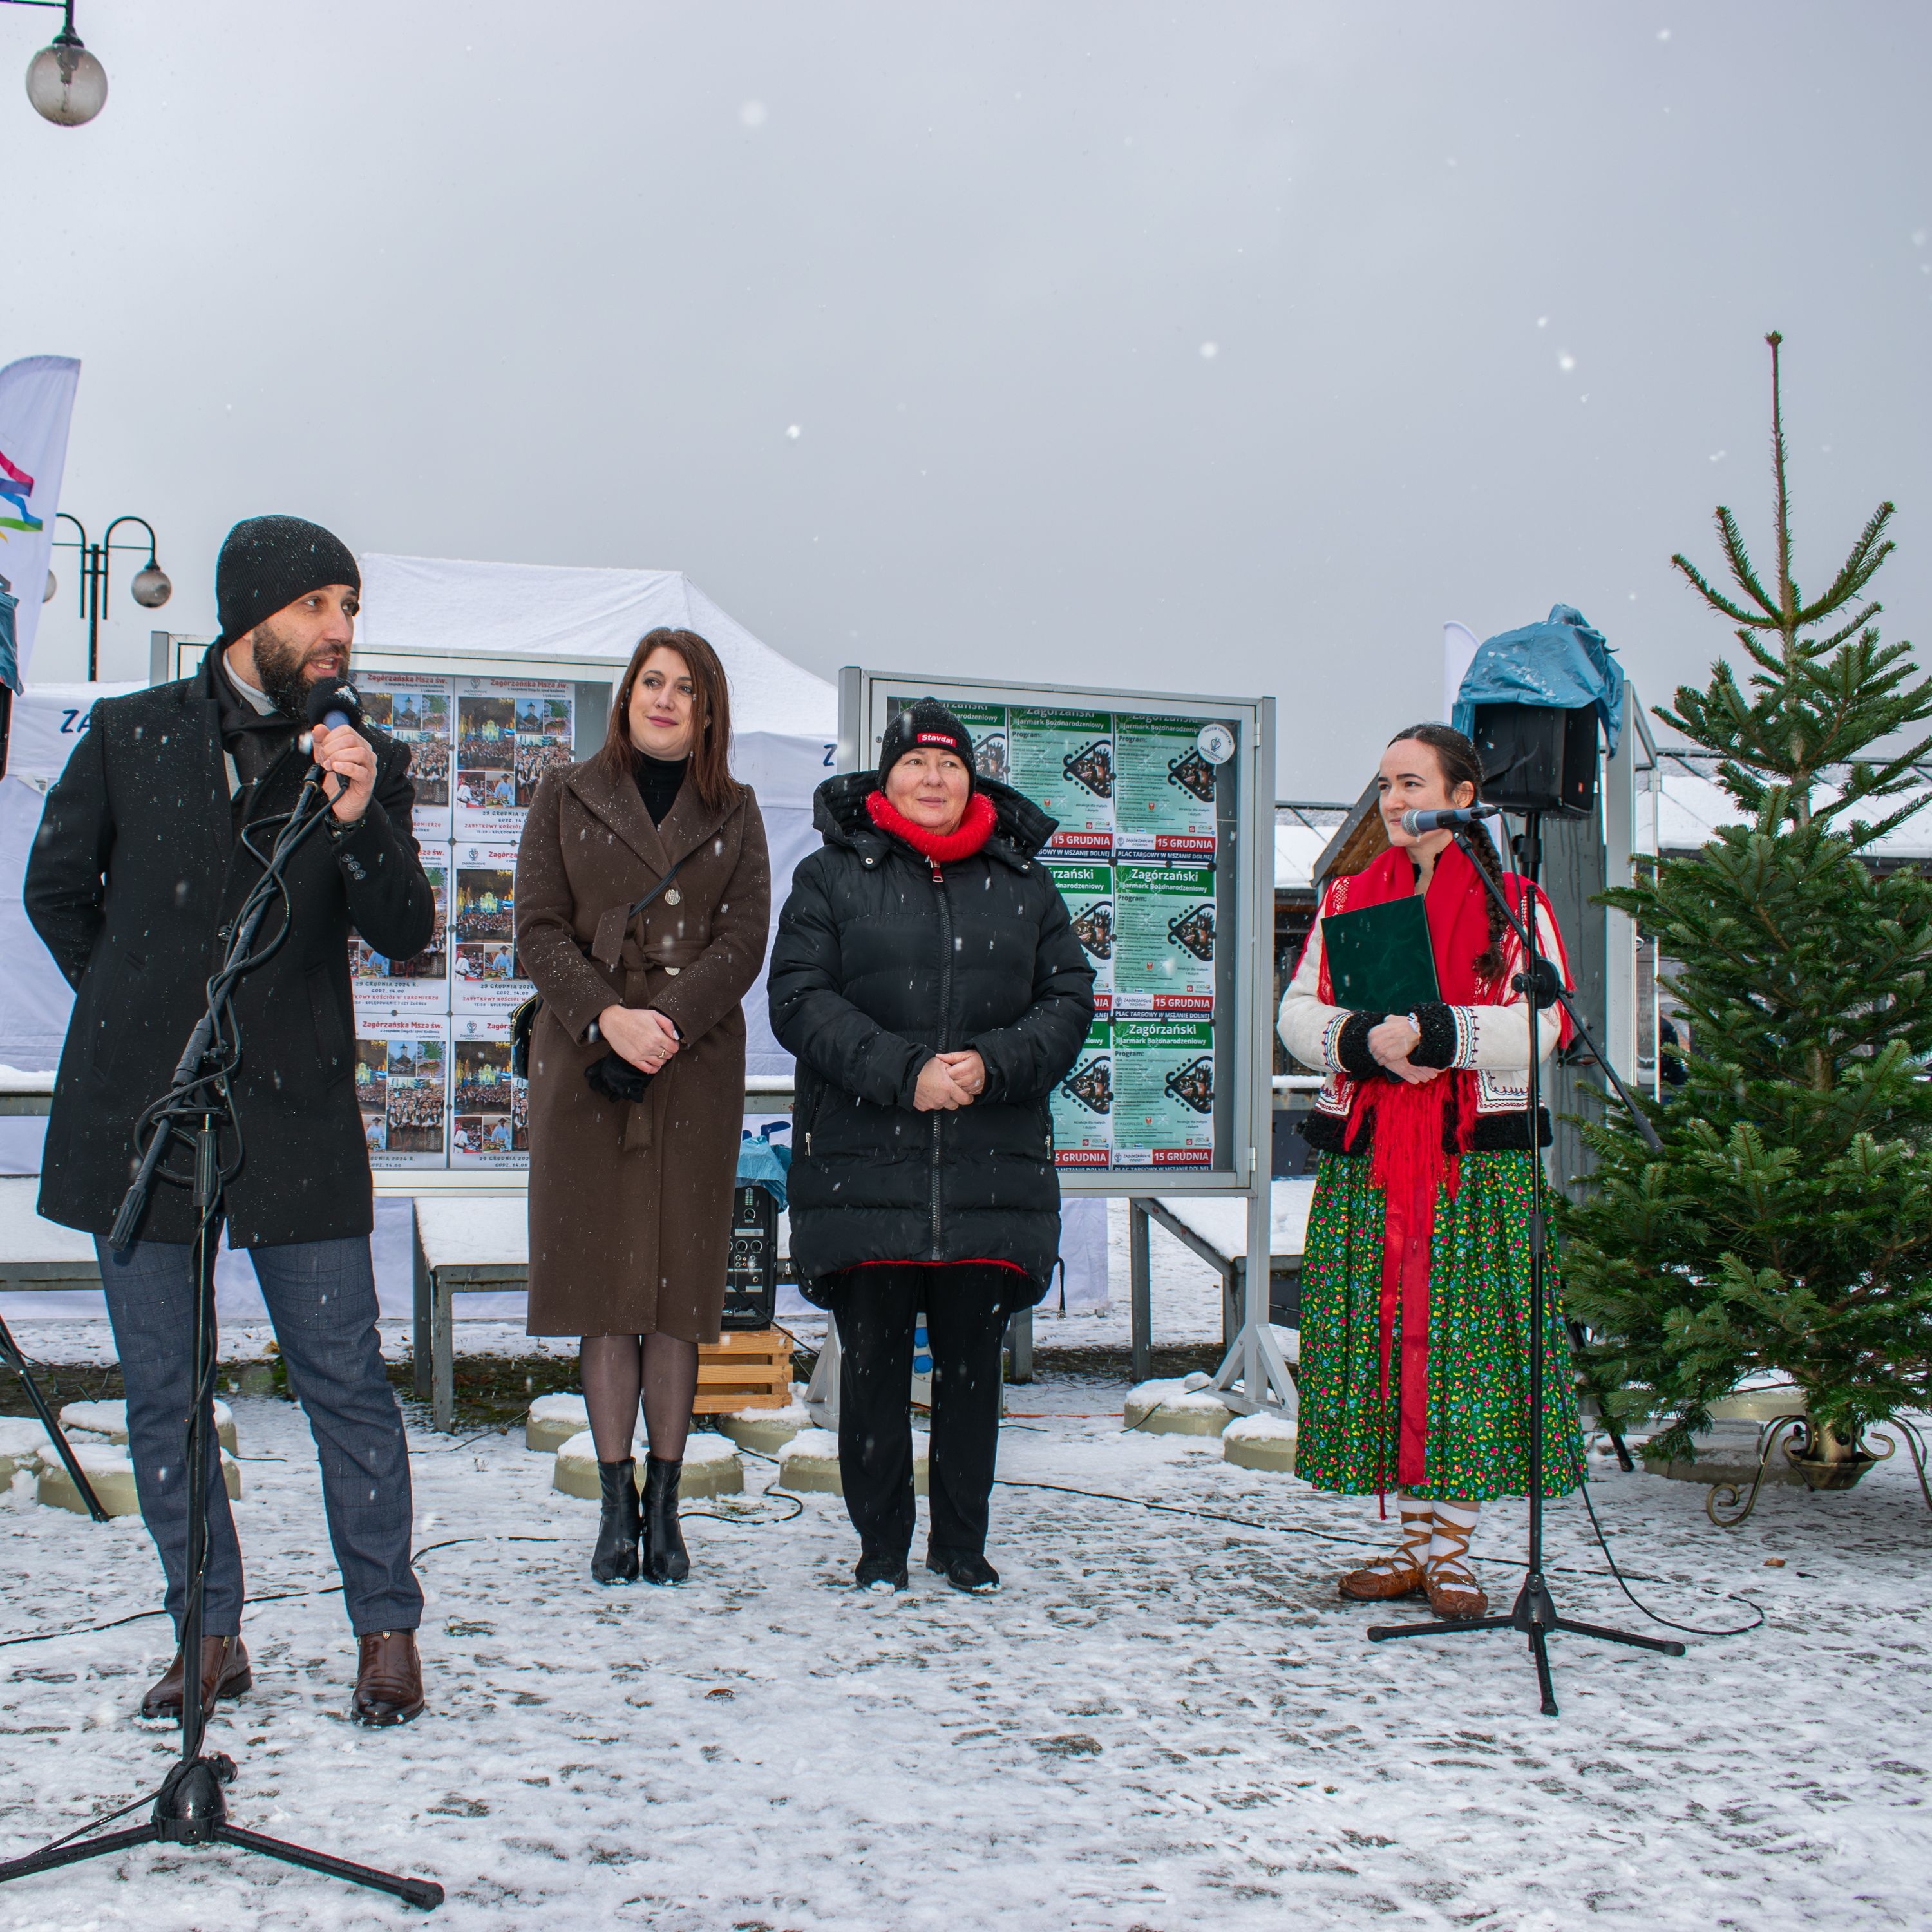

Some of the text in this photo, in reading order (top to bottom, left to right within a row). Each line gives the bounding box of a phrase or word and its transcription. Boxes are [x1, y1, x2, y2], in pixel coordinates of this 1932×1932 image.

[415, 675, 433, 683] Msza
[1045, 719, 1104, 730] Bożonarodzeniowy
[922, 734, 953, 744] Stavdal
[1054, 835, 1110, 846] 15 GRUDNIA
[1157, 838, 1168, 847] 15
[1172, 838, 1213, 849] GRUDNIA
[1132, 869, 1198, 882] Zagórzański
[1150, 883, 1208, 893] Bożonarodzeniowy
[1155, 998, 1166, 1007] 15
[1168, 999, 1210, 1008] GRUDNIA
[1129, 1024, 1196, 1036] Zagórzański
[1147, 1037, 1206, 1046] Bożonarodzeniowy
[1063, 1153, 1106, 1162] GRUDNIA
[1167, 1152, 1209, 1161] GRUDNIA
